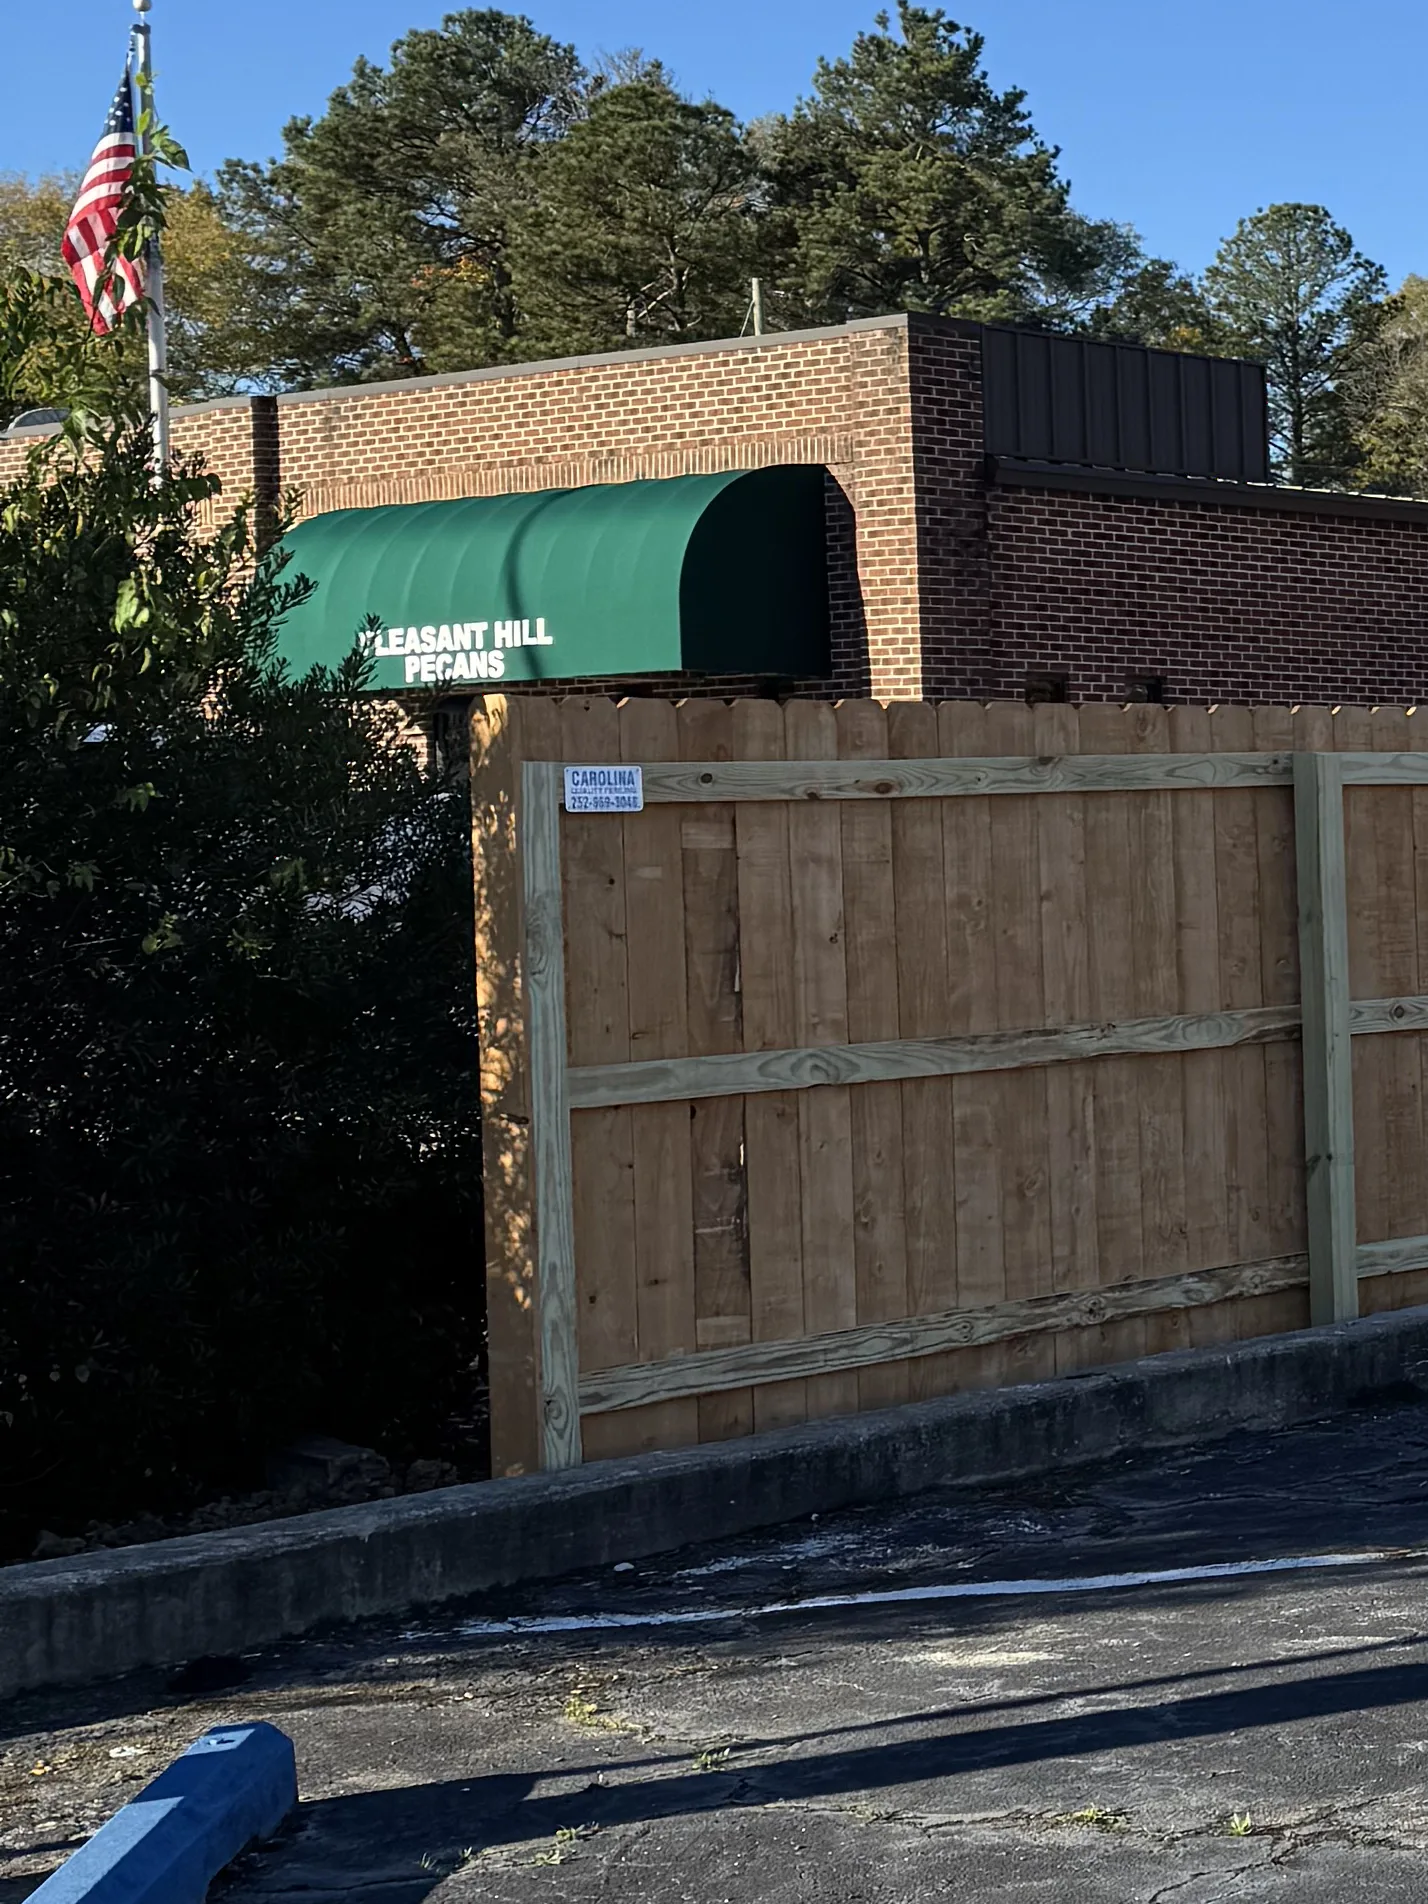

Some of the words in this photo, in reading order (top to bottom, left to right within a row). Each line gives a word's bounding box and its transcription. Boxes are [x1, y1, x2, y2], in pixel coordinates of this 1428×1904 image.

[493, 617, 554, 649] HILL
[405, 650, 505, 683] PECANS
[572, 770, 635, 786] CAROLINA
